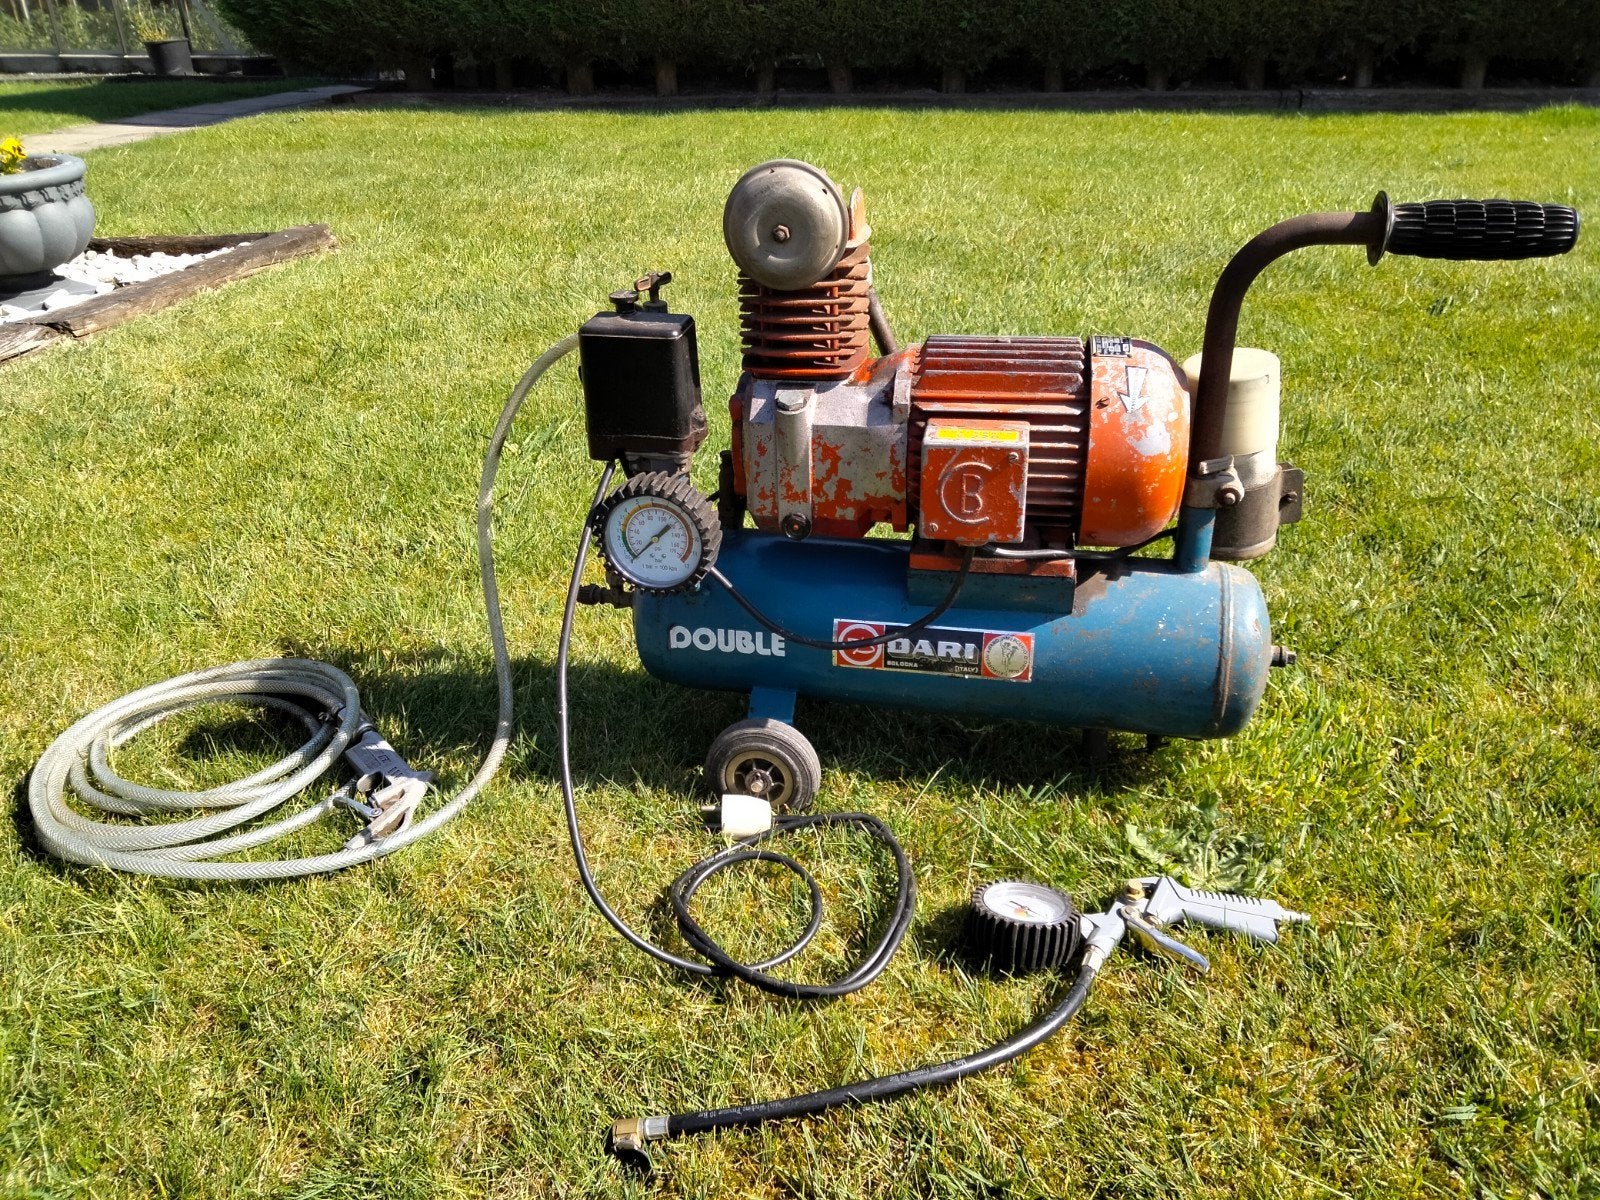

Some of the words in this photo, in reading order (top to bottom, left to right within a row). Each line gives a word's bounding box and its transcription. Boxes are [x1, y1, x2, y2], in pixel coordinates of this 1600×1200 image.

[669, 625, 786, 657] DOUBLE
[887, 637, 978, 661] DARI
[886, 660, 919, 668] BOLOGNA
[954, 665, 979, 674] (ITALY)
